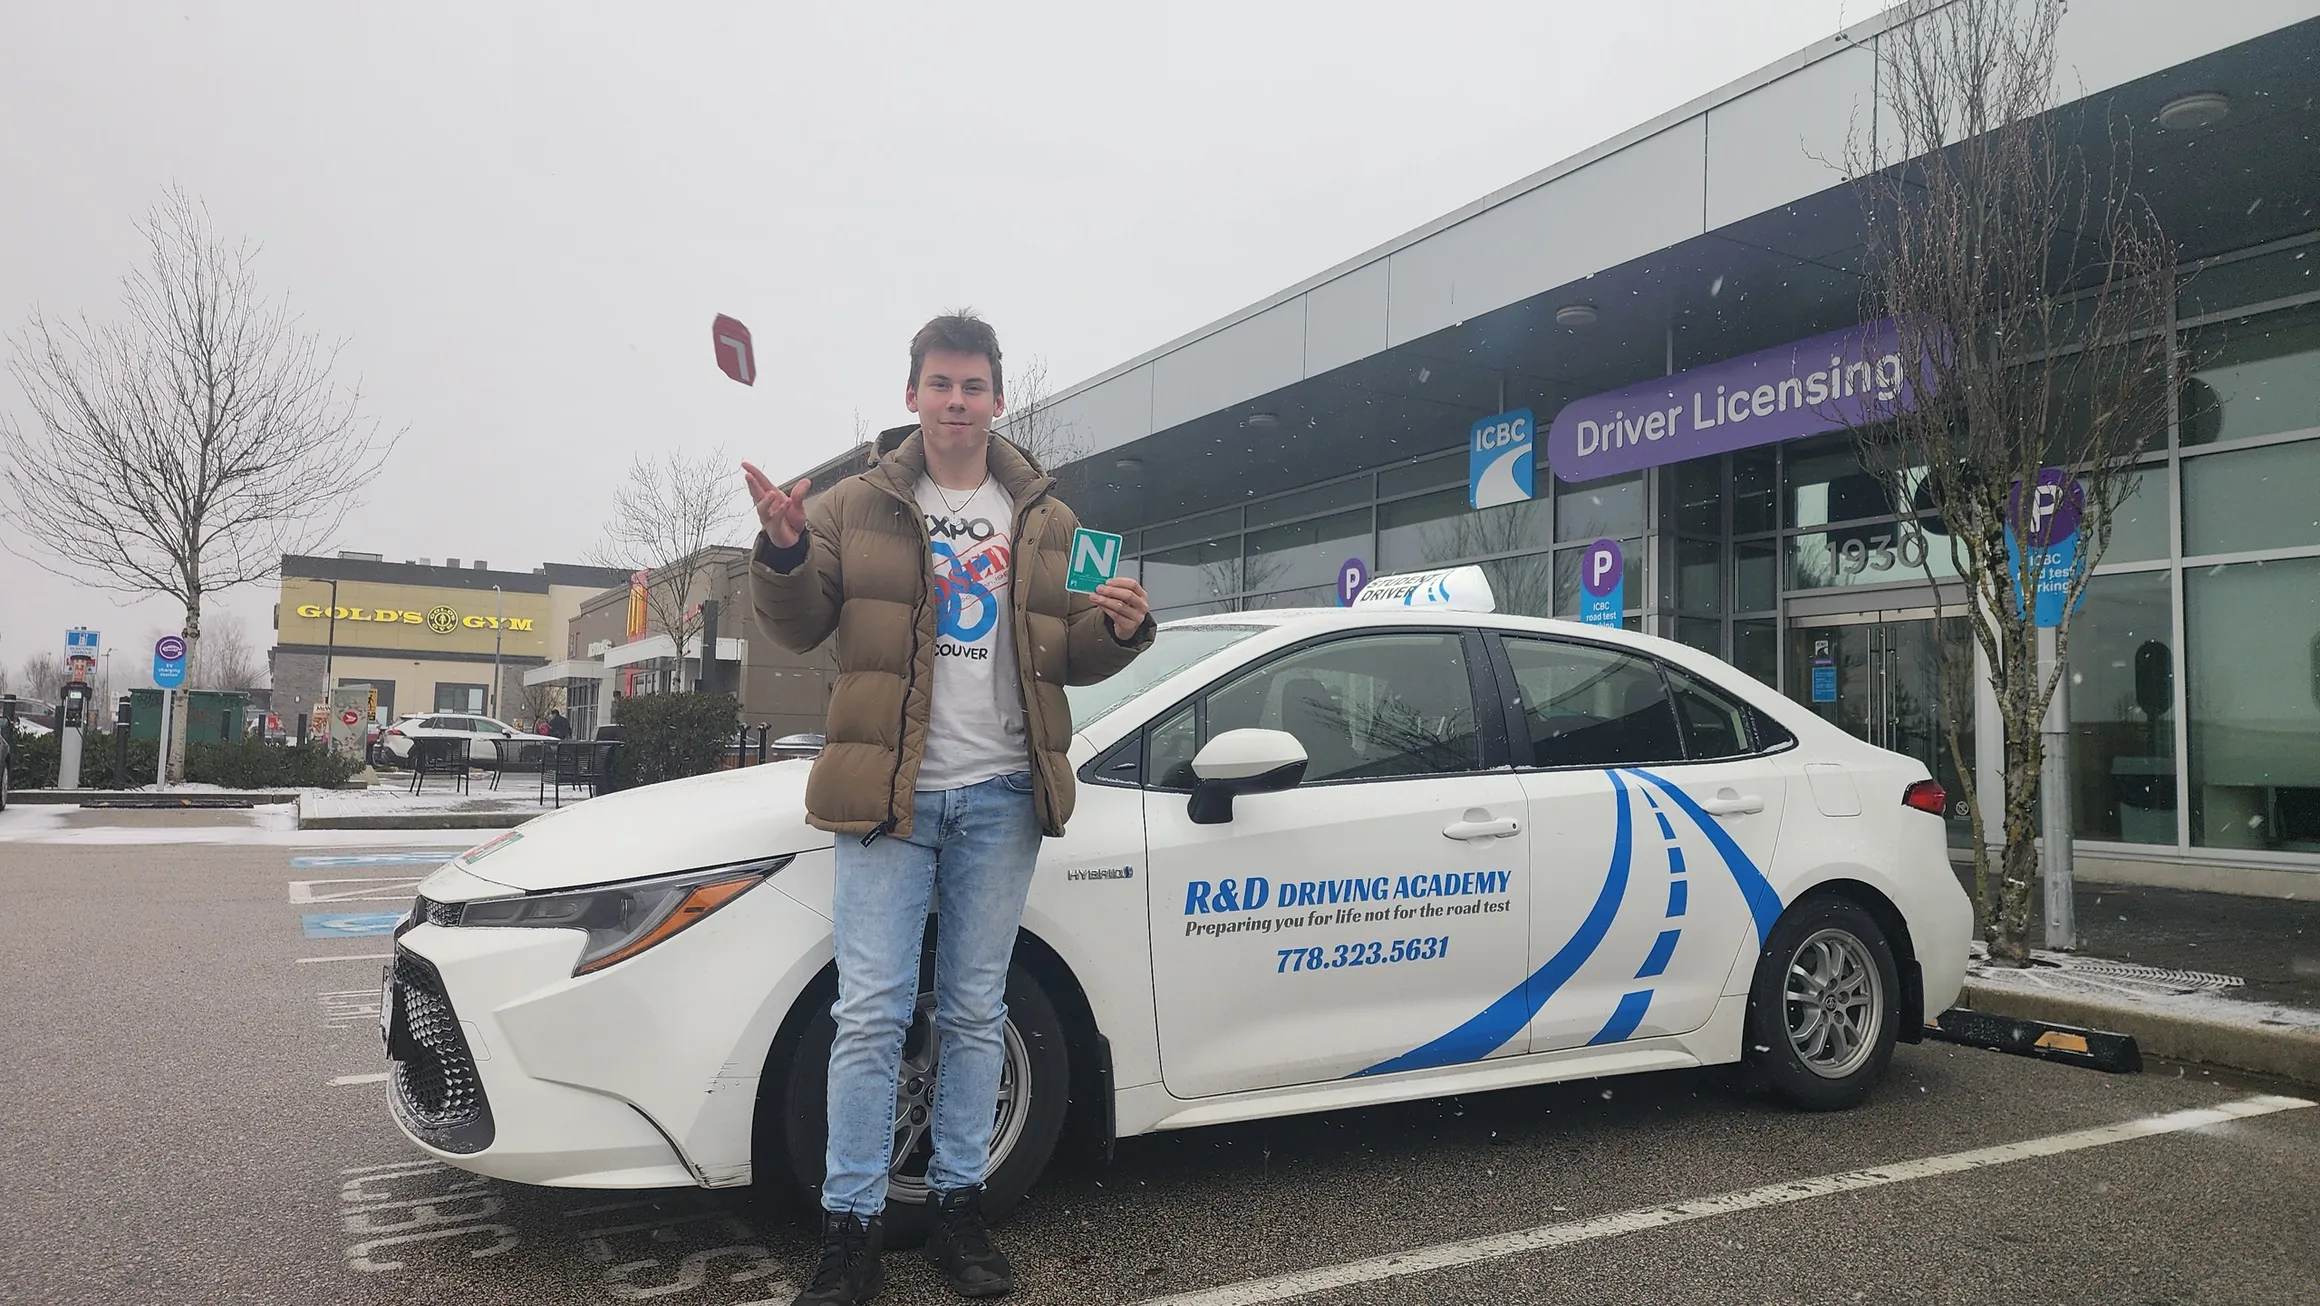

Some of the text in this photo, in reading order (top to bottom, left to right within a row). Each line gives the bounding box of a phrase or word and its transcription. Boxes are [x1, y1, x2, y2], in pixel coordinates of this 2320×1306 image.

[1577, 351, 1905, 457] Driver Licensing
[1475, 417, 1526, 451] ICBC
[2030, 484, 2063, 533] P
[924, 514, 995, 541] XPO
[1074, 534, 1116, 578] N
[1594, 550, 1613, 587] P
[1825, 531, 1929, 576] 1930
[2030, 553, 2061, 566] ICBC
[1346, 567, 1360, 600] P
[1360, 585, 1417, 602] DRIVER
[1367, 573, 1441, 589] STUDENT
[297, 604, 533, 631] GOLD'S GYM
[1586, 610, 1617, 622] road test
[1593, 601, 1610, 611] ICBC
[1067, 868, 1124, 881] HYBRID
[1184, 870, 1511, 915] R&D DRIVING ACADEMY
[1185, 899, 1511, 938] Preparing you for life not for the road test
[1277, 936, 1450, 973] 778.323.5631
